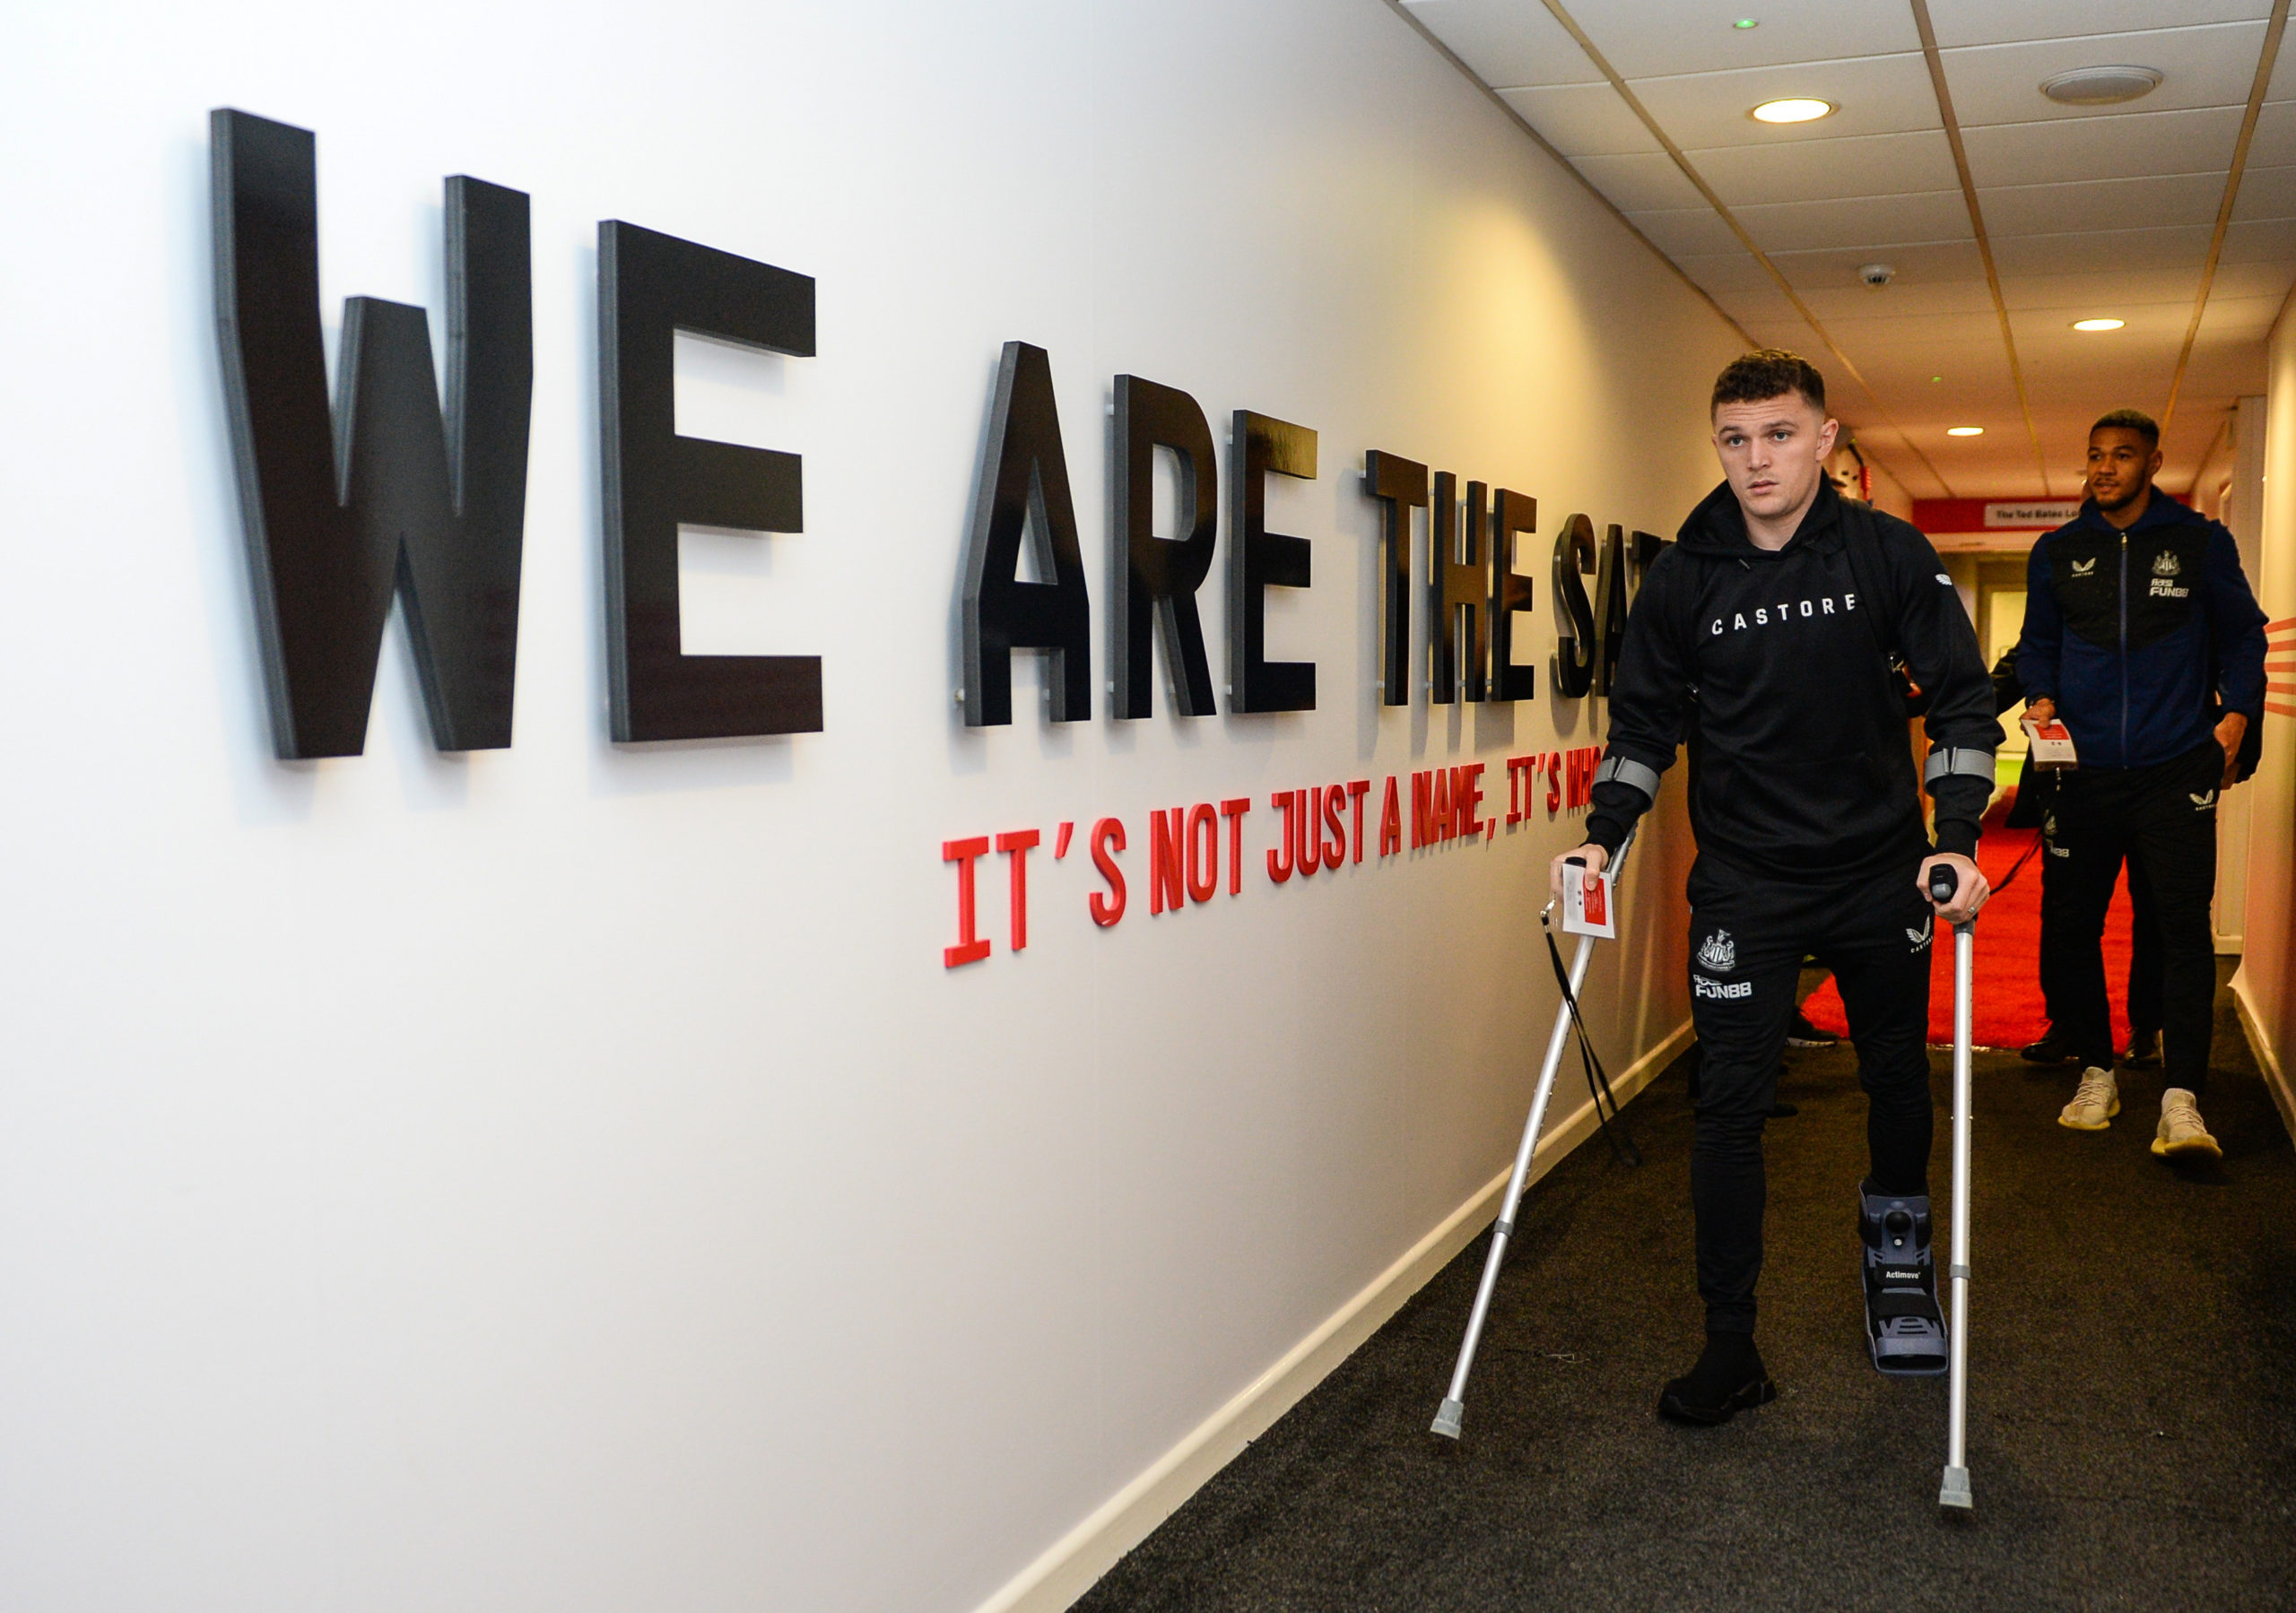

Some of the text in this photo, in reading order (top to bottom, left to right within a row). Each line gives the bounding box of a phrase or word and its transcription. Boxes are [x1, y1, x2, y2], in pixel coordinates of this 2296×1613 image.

[210, 107, 823, 759] WE
[961, 341, 1318, 726] ARE
[1365, 449, 1537, 706] THE
[1711, 594, 1856, 635] CASTORE
[942, 818, 1126, 968] IT'S
[1150, 797, 1250, 915] NOT
[1266, 779, 1370, 883] JUST
[1379, 776, 1401, 856] A
[1412, 763, 1496, 849] NAME,
[1507, 752, 1561, 825] IT'S
